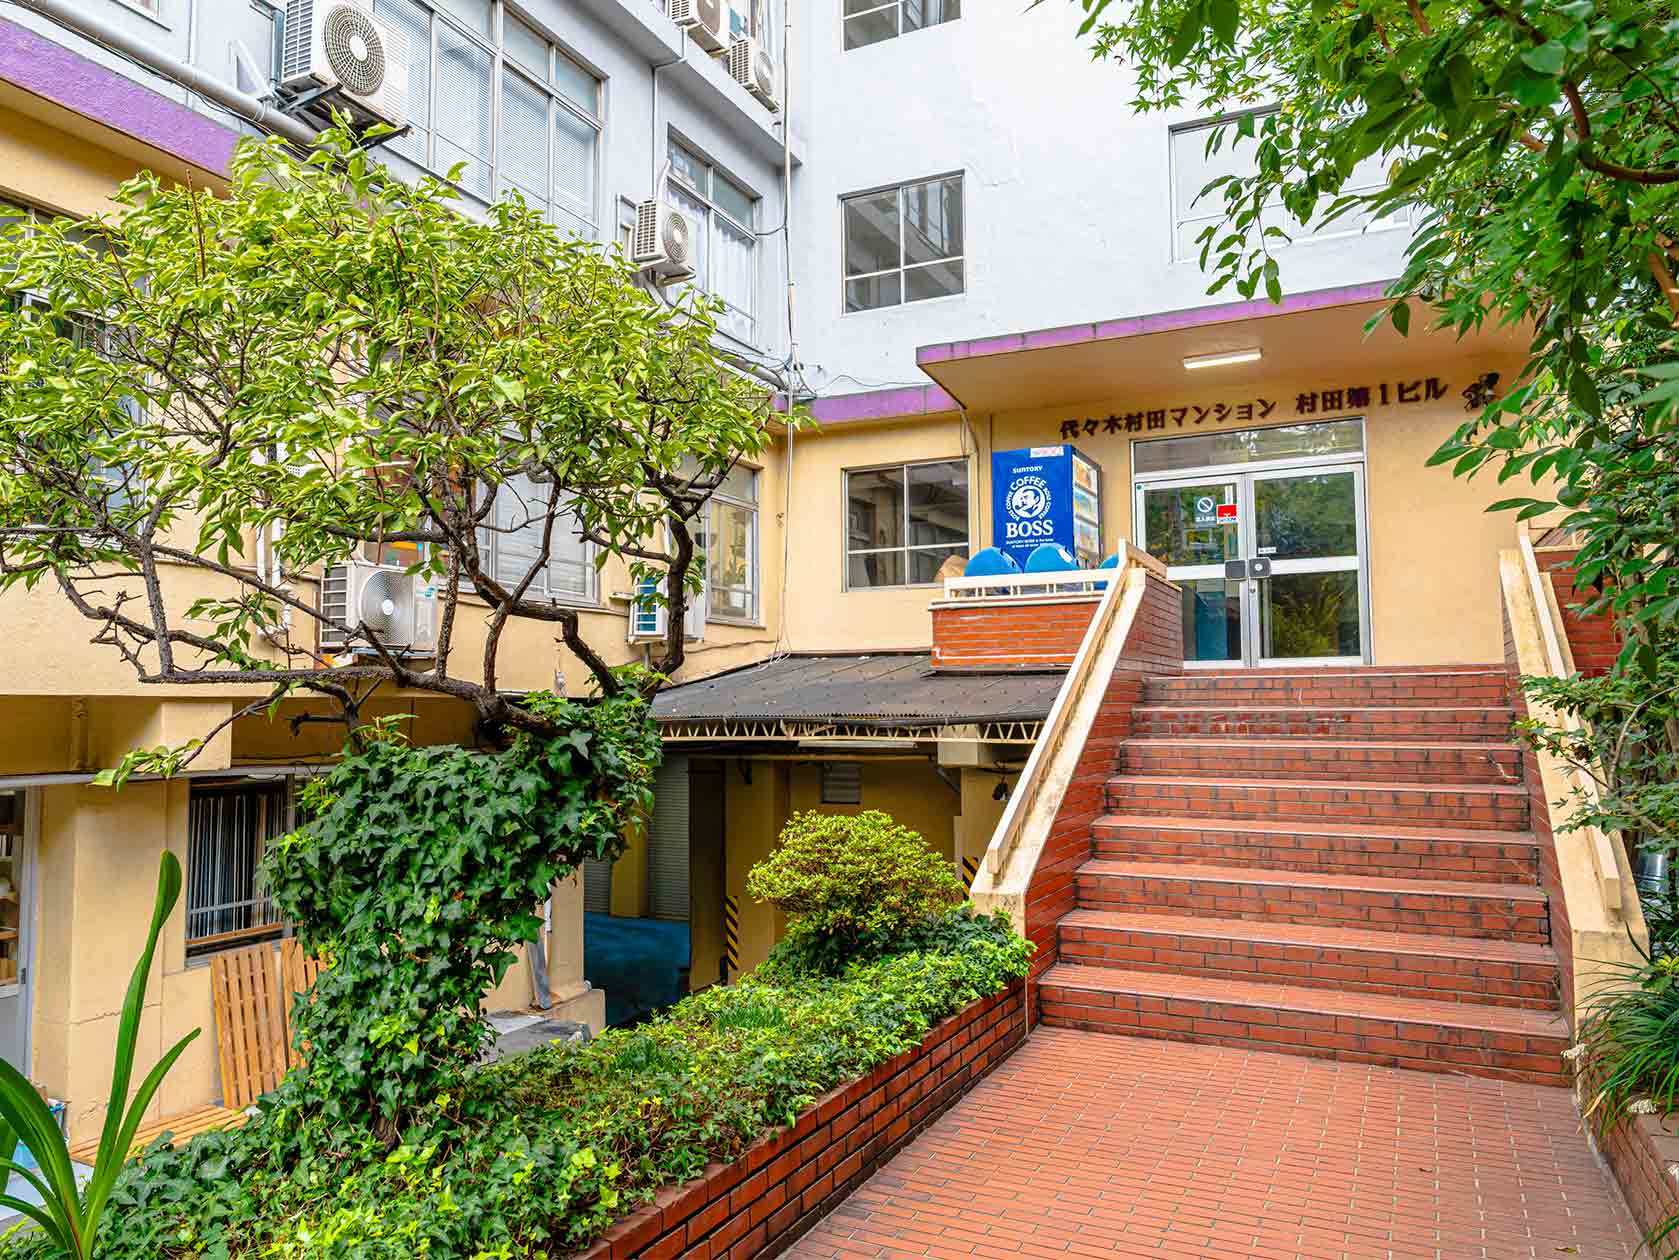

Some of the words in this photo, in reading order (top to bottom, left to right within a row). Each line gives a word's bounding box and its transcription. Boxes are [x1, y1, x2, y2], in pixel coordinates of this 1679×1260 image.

[1059, 398, 1276, 440] 代々木村田マンション
[1012, 465, 1043, 474] SUNTORY
[1010, 476, 1047, 490] COFFEE
[1006, 519, 1054, 538] BOSS
